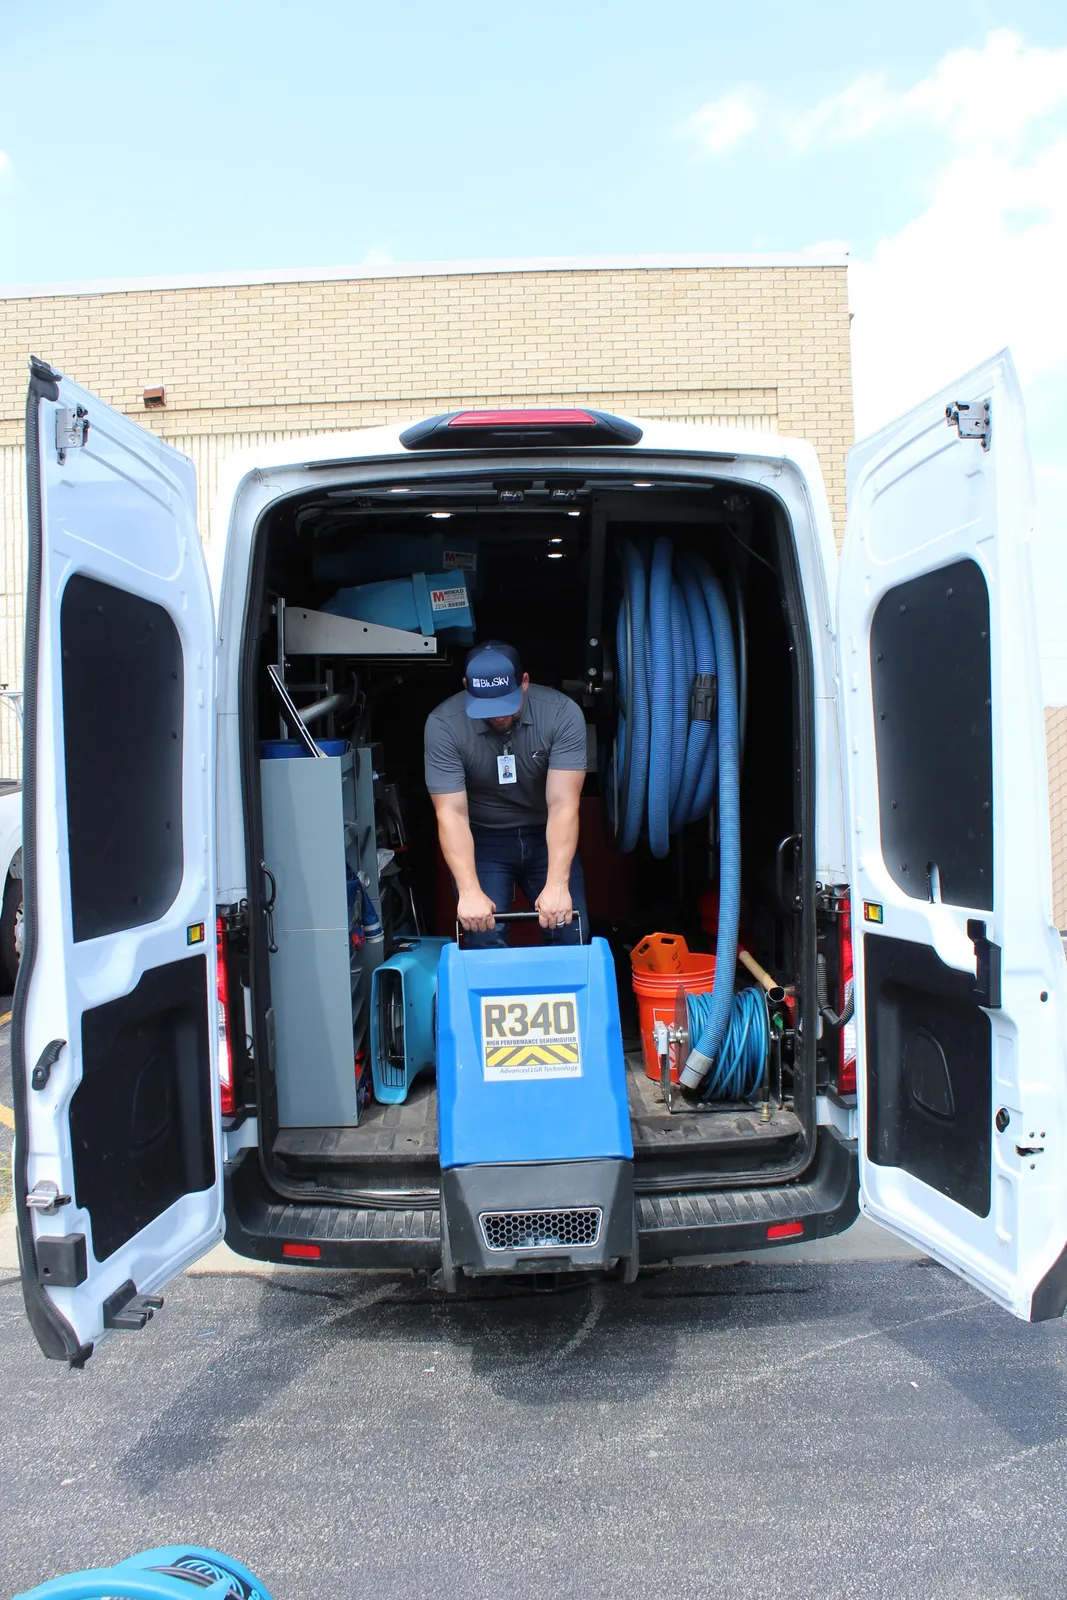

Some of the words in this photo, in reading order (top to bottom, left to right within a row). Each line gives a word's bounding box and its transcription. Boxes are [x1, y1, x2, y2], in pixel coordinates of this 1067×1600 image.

[432, 592, 444, 602] M
[485, 1001, 576, 1038] R340
[500, 1066, 530, 1074] Advanced
[530, 1065, 543, 1073] LGR
[544, 1063, 578, 1073] Technology
